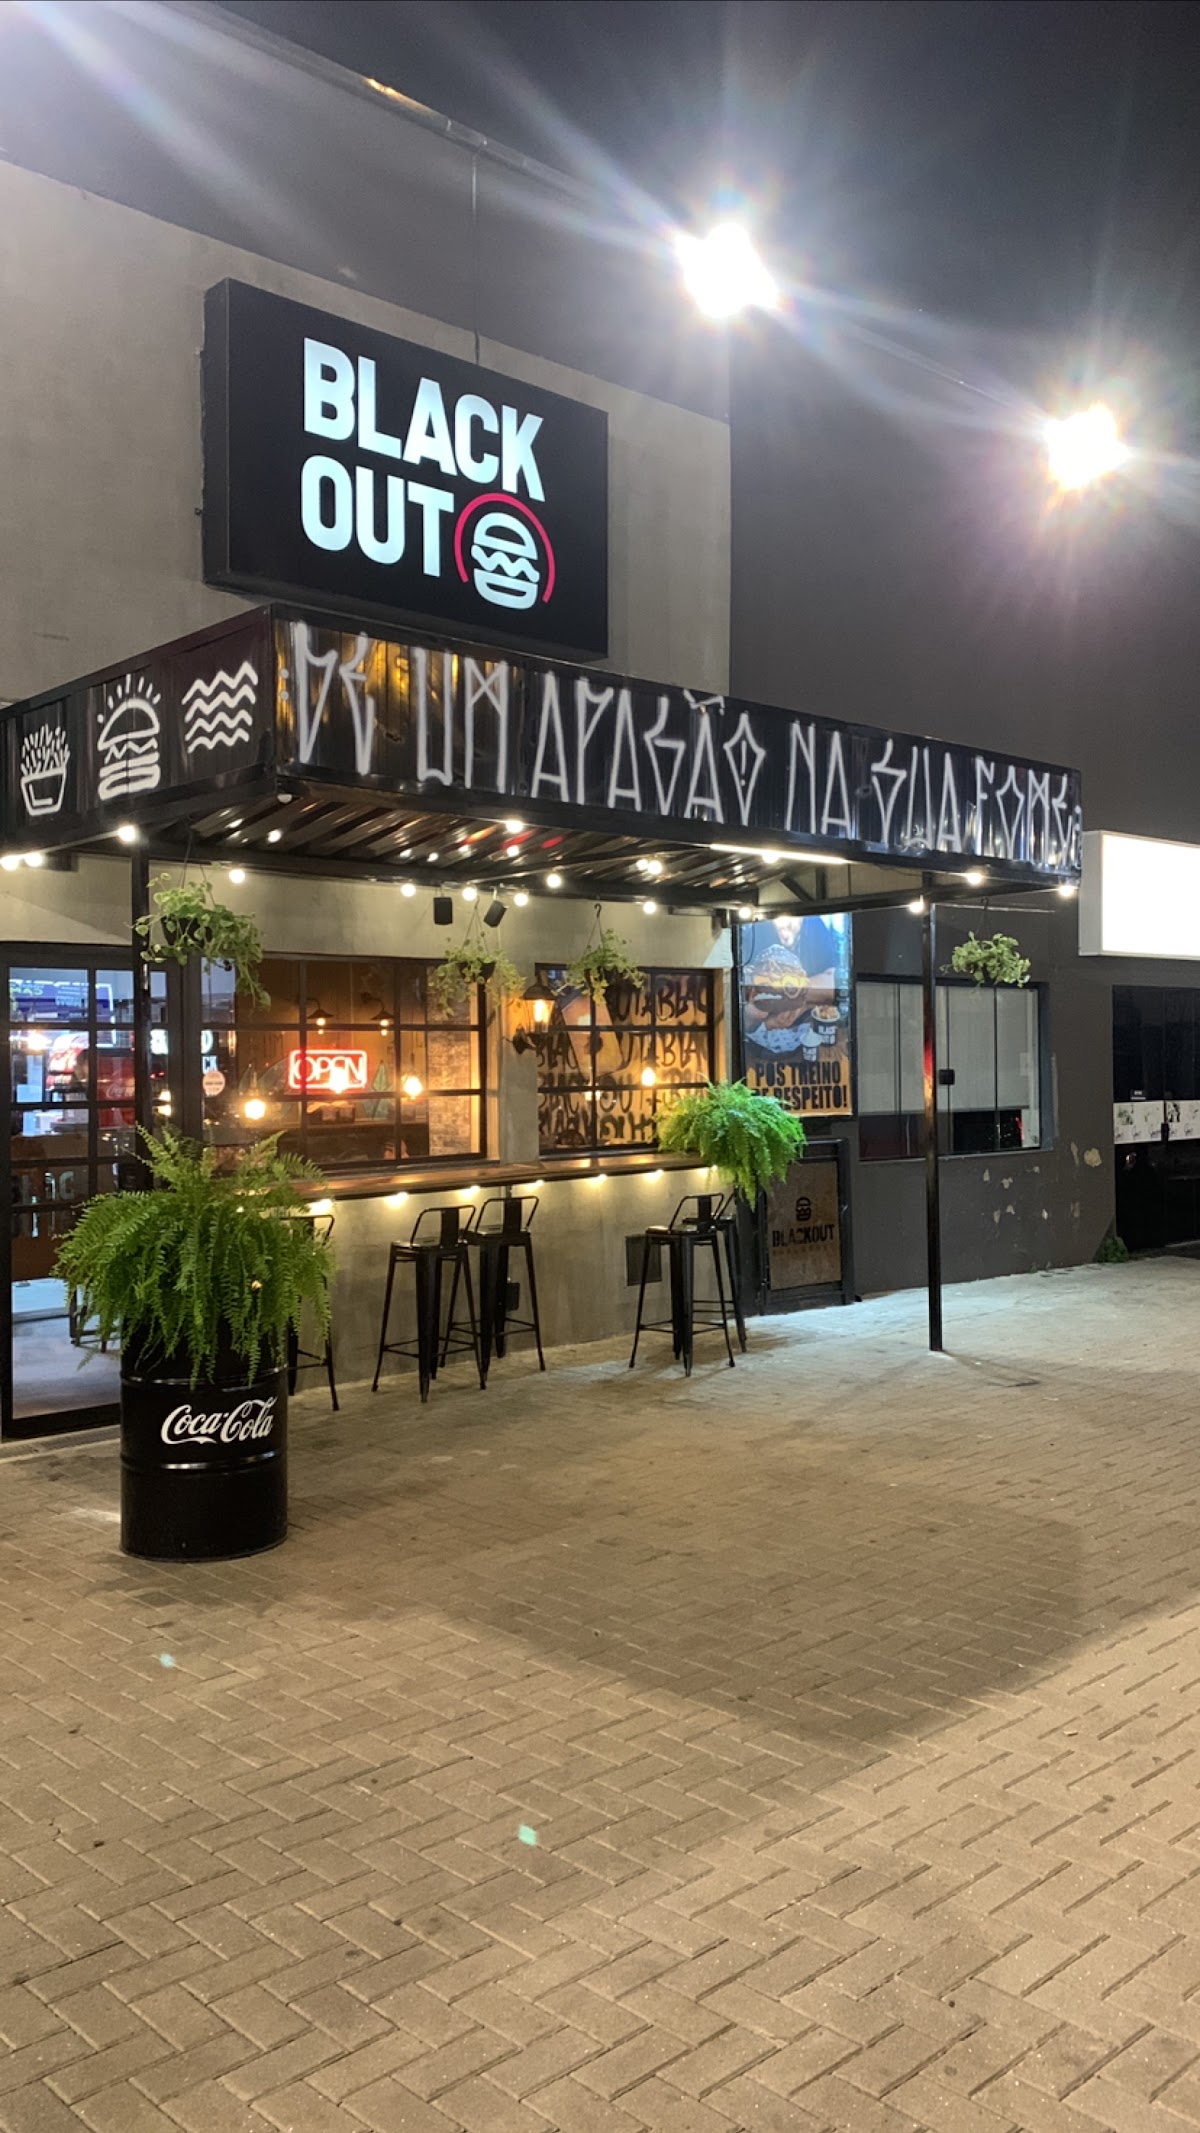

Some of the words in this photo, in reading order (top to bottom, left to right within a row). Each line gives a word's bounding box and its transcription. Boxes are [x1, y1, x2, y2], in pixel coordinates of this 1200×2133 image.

[304, 337, 545, 502] BLACK
[301, 455, 454, 577] OUT
[786, 720, 853, 840] NA
[791, 1060, 841, 1085] TREINO
[772, 1223, 835, 1248] BLACKOUT
[160, 1396, 278, 1445] Coca-Cola
